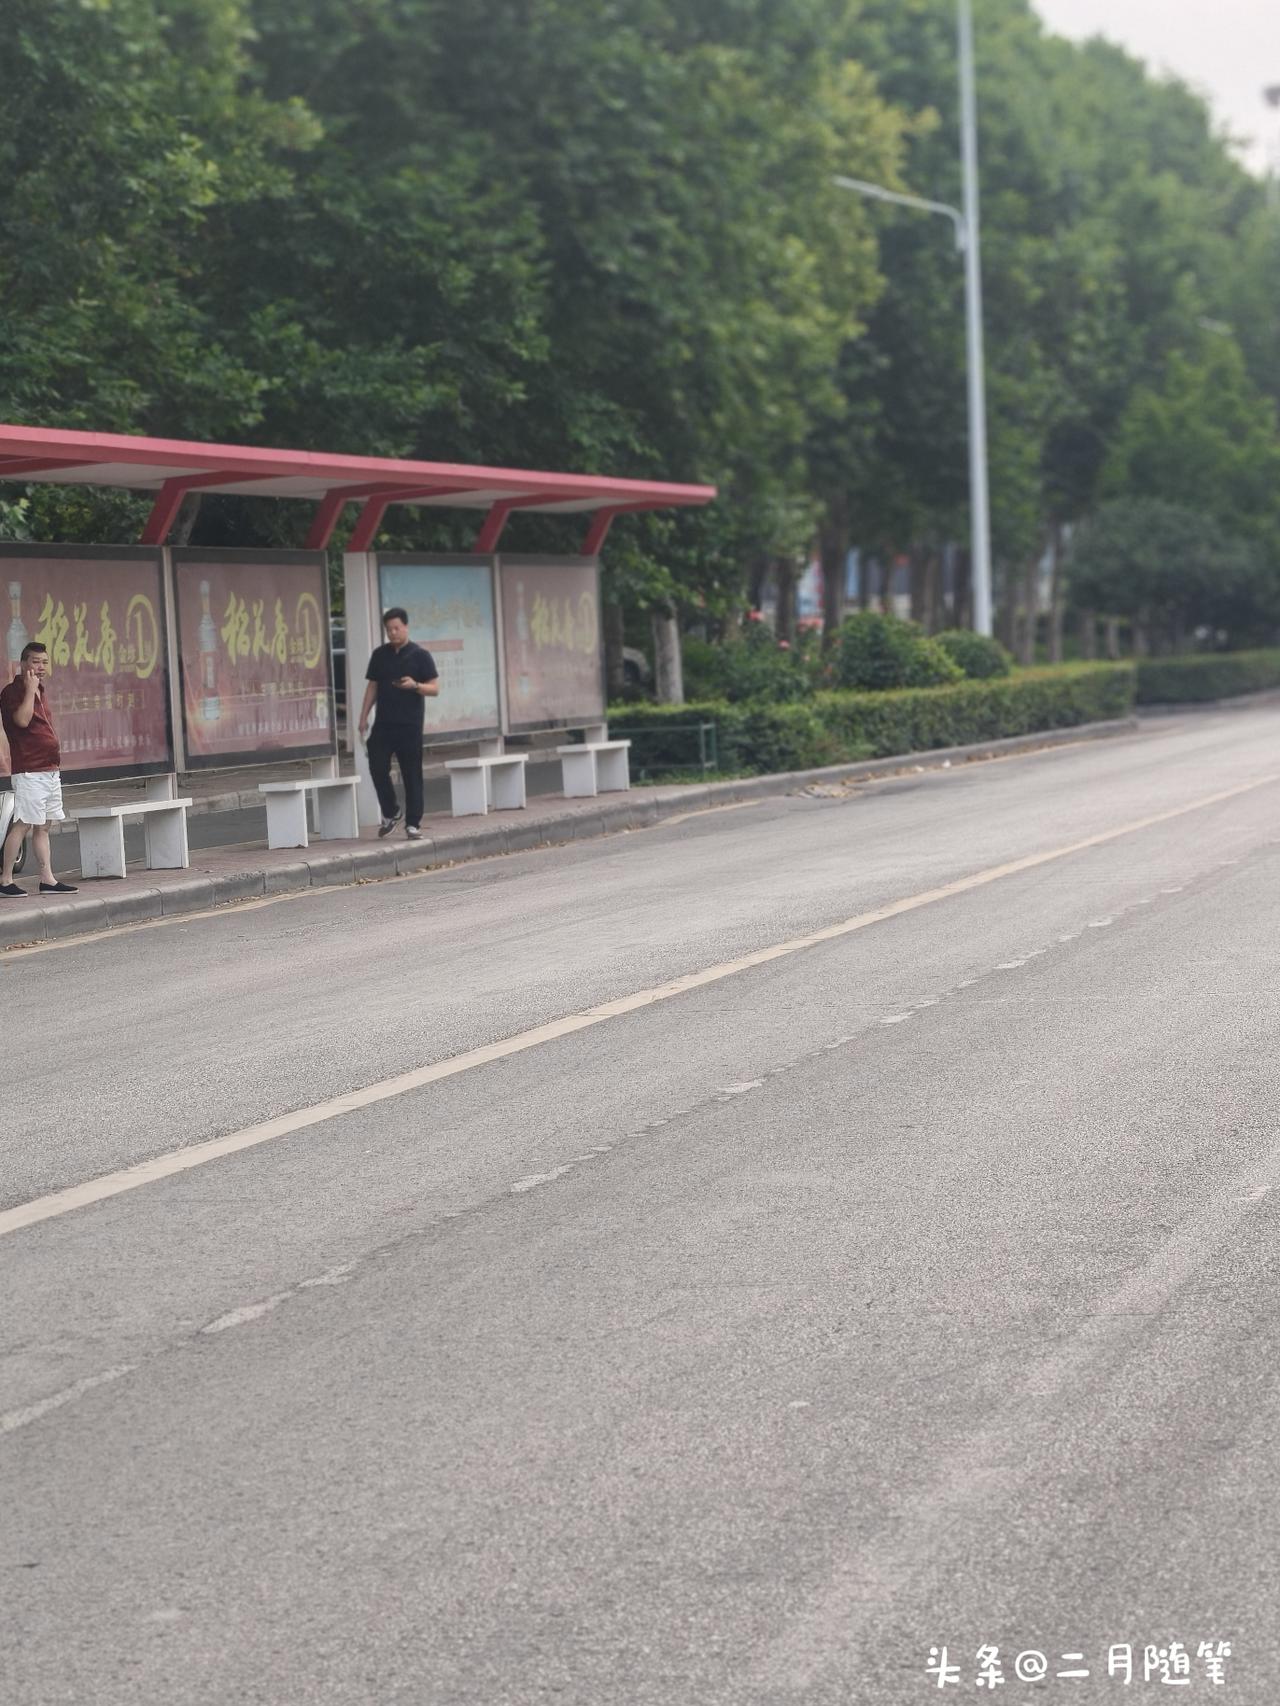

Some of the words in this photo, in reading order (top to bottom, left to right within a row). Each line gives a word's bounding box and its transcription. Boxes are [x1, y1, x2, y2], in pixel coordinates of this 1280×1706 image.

[34, 592, 117, 676] 稻花香
[221, 591, 289, 666] 稻花香
